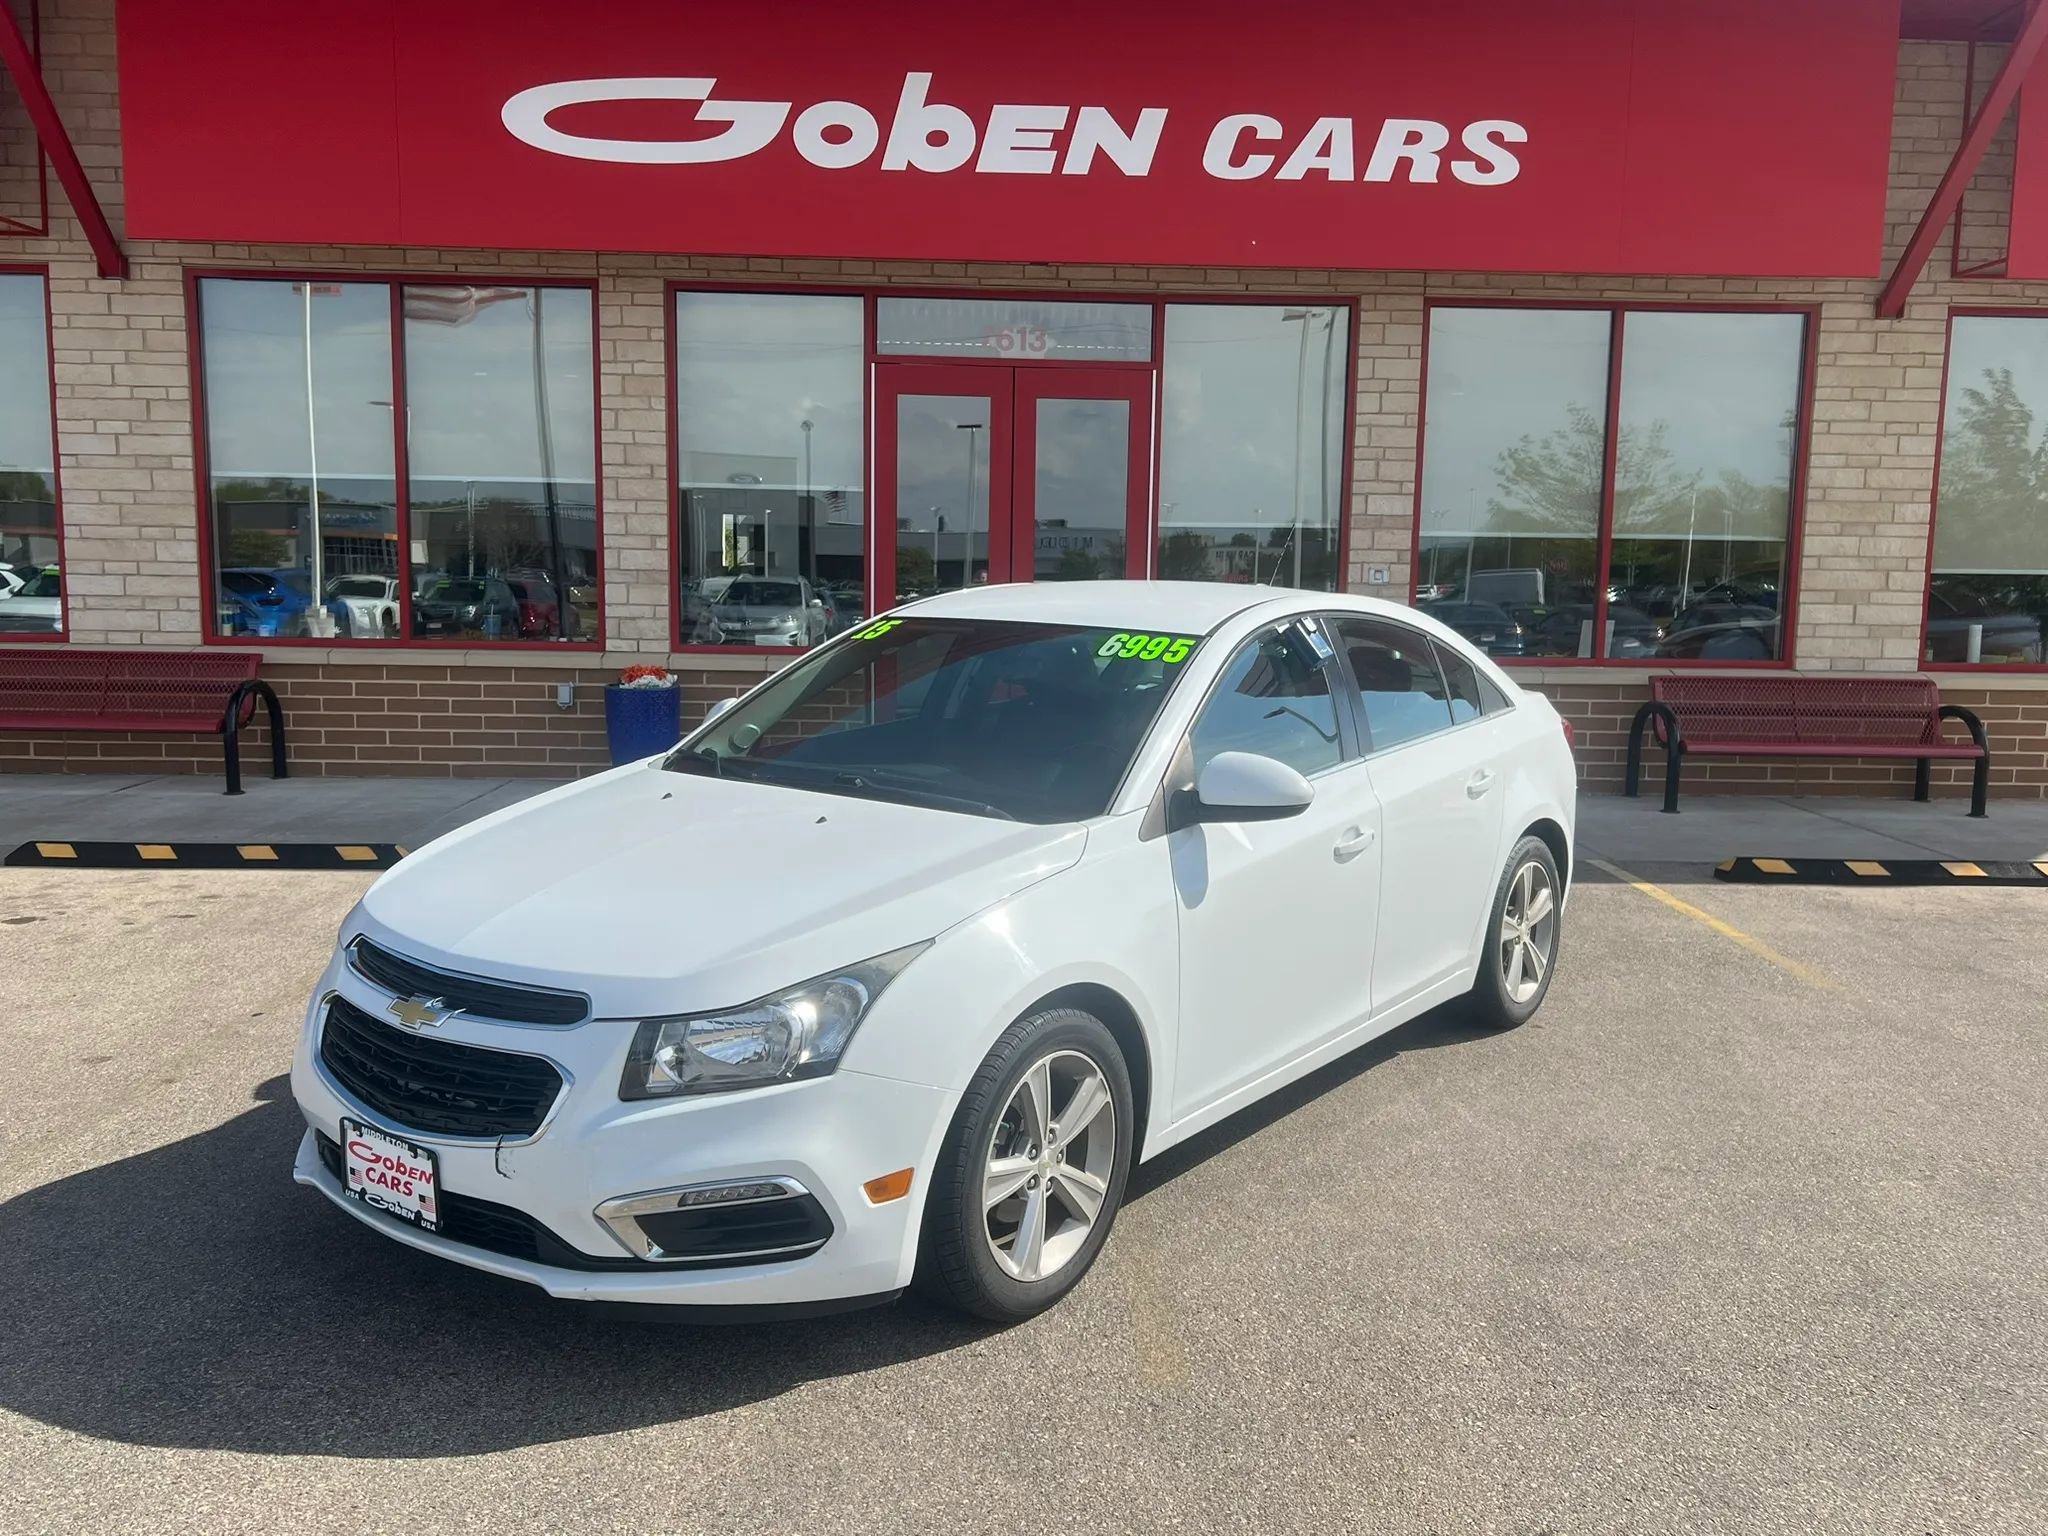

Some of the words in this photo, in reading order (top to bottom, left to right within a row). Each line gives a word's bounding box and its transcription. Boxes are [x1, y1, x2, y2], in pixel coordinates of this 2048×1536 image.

[1202, 114, 1528, 186] CARS
[996, 326, 1047, 352] 613
[1097, 633, 1196, 664] 6995
[361, 1126, 409, 1150] MIDDLETON
[345, 1189, 360, 1200] USA
[365, 1167, 414, 1197] CARS
[421, 1219, 436, 1231] USA
